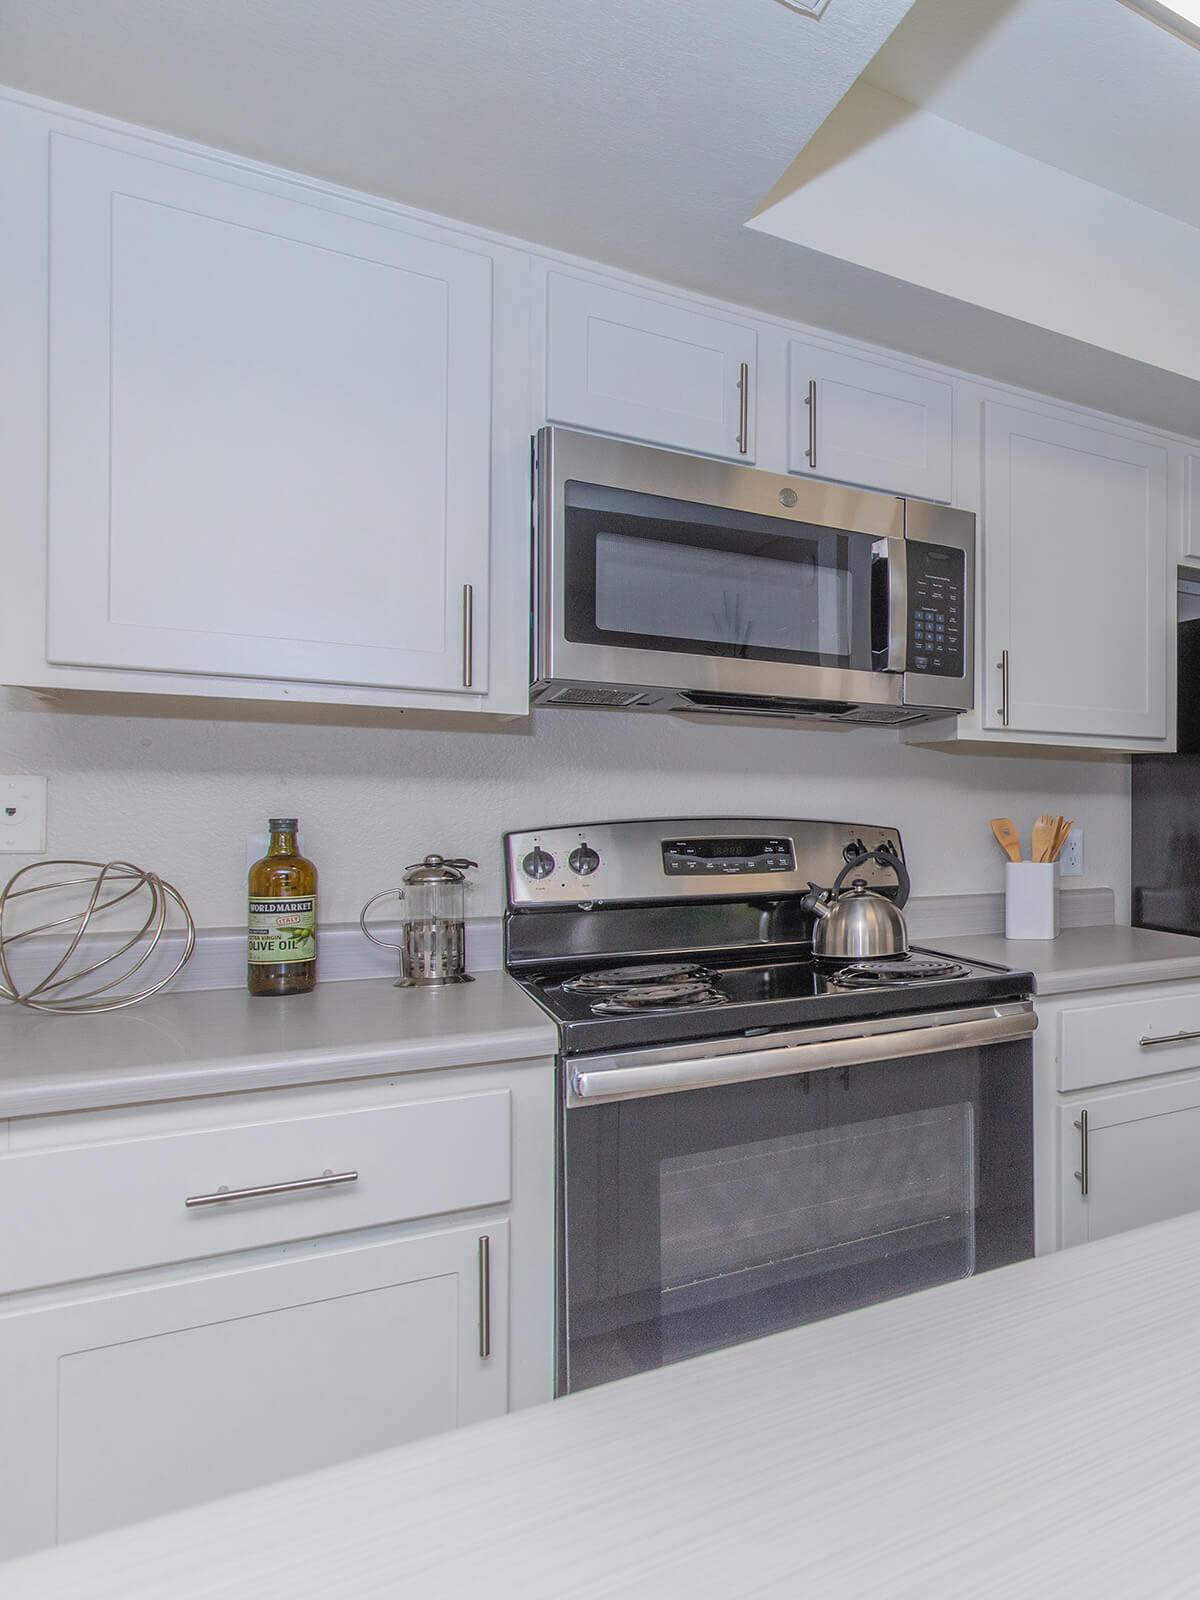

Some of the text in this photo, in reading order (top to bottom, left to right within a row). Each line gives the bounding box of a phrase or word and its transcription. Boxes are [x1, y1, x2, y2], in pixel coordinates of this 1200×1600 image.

[251, 903, 311, 912] WORLD MARKET
[279, 941, 298, 950] OIL
